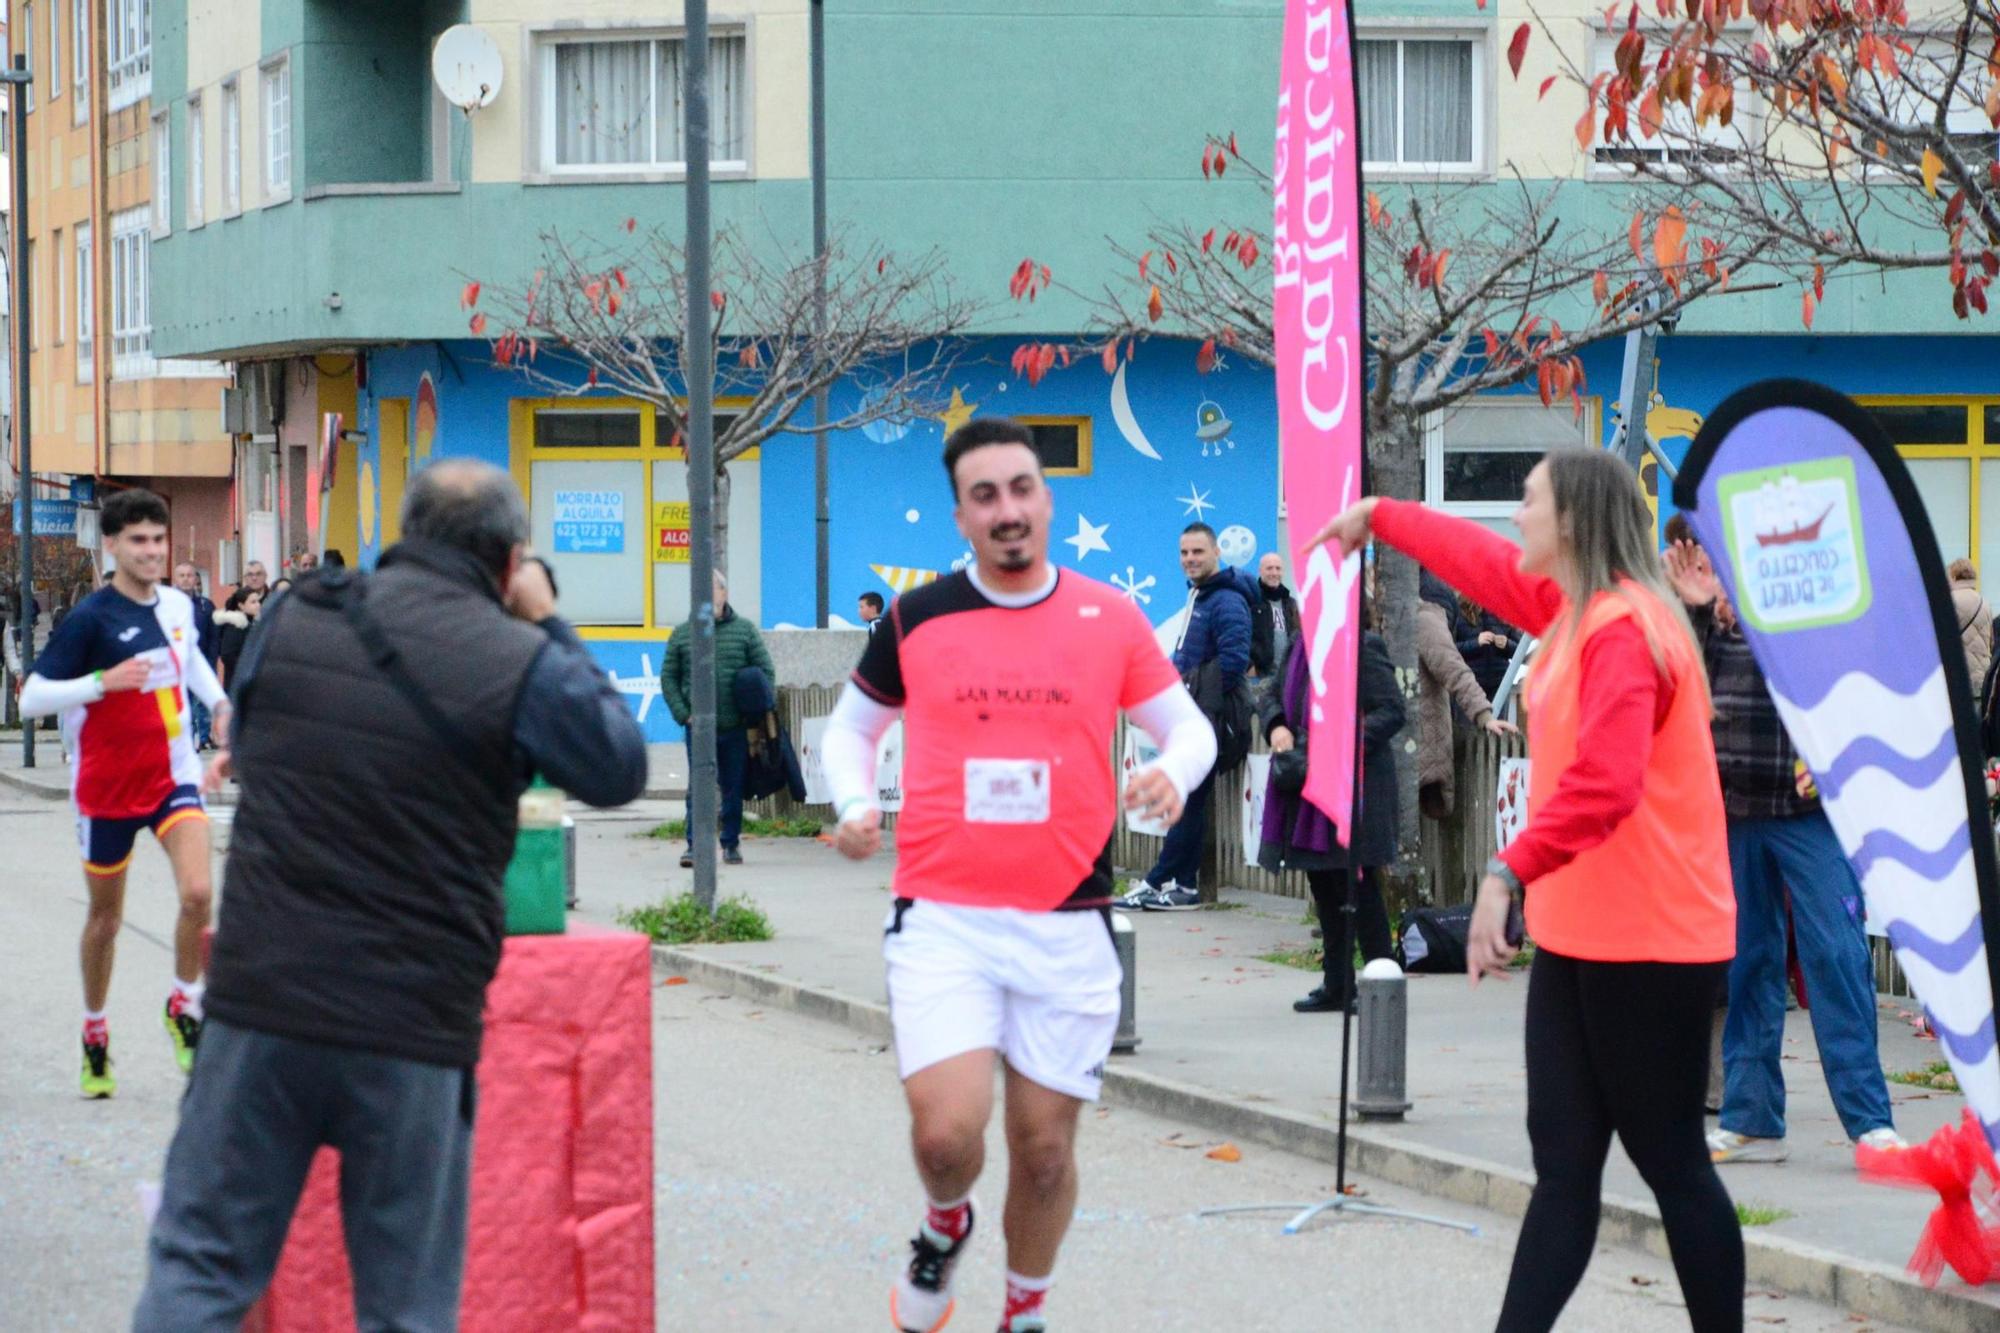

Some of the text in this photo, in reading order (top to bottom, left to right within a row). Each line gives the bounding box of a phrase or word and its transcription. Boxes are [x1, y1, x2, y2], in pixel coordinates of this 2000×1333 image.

[556, 492, 620, 505] MORRAZO
[562, 506, 616, 519] ALQUILA
[556, 524, 577, 537] 622
[580, 524, 599, 537] 172
